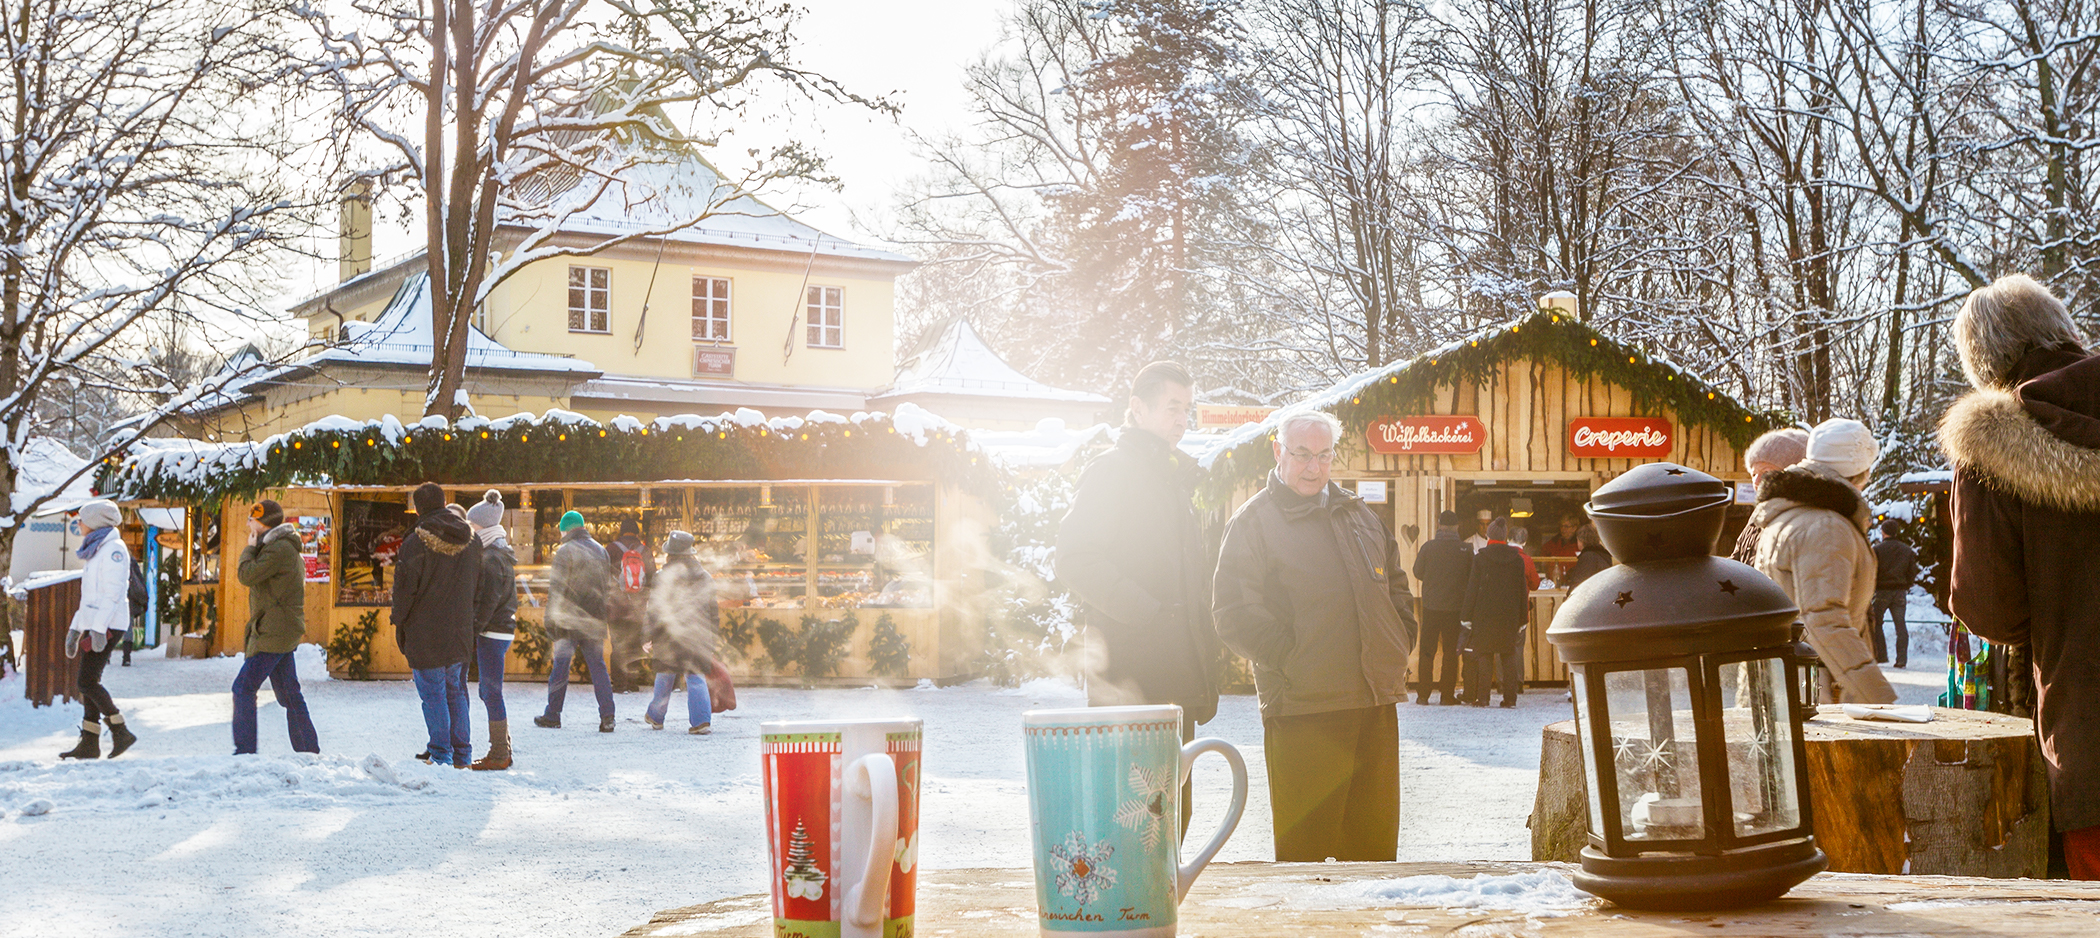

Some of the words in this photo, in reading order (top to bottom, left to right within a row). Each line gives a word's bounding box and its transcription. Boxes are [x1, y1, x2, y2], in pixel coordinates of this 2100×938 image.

[1201, 409, 1272, 425] Himmelsdorfschä
[1378, 423, 1473, 450] Waffelbäckerei
[1574, 425, 1667, 452] Creperie
[1117, 906, 1151, 921] Turm
